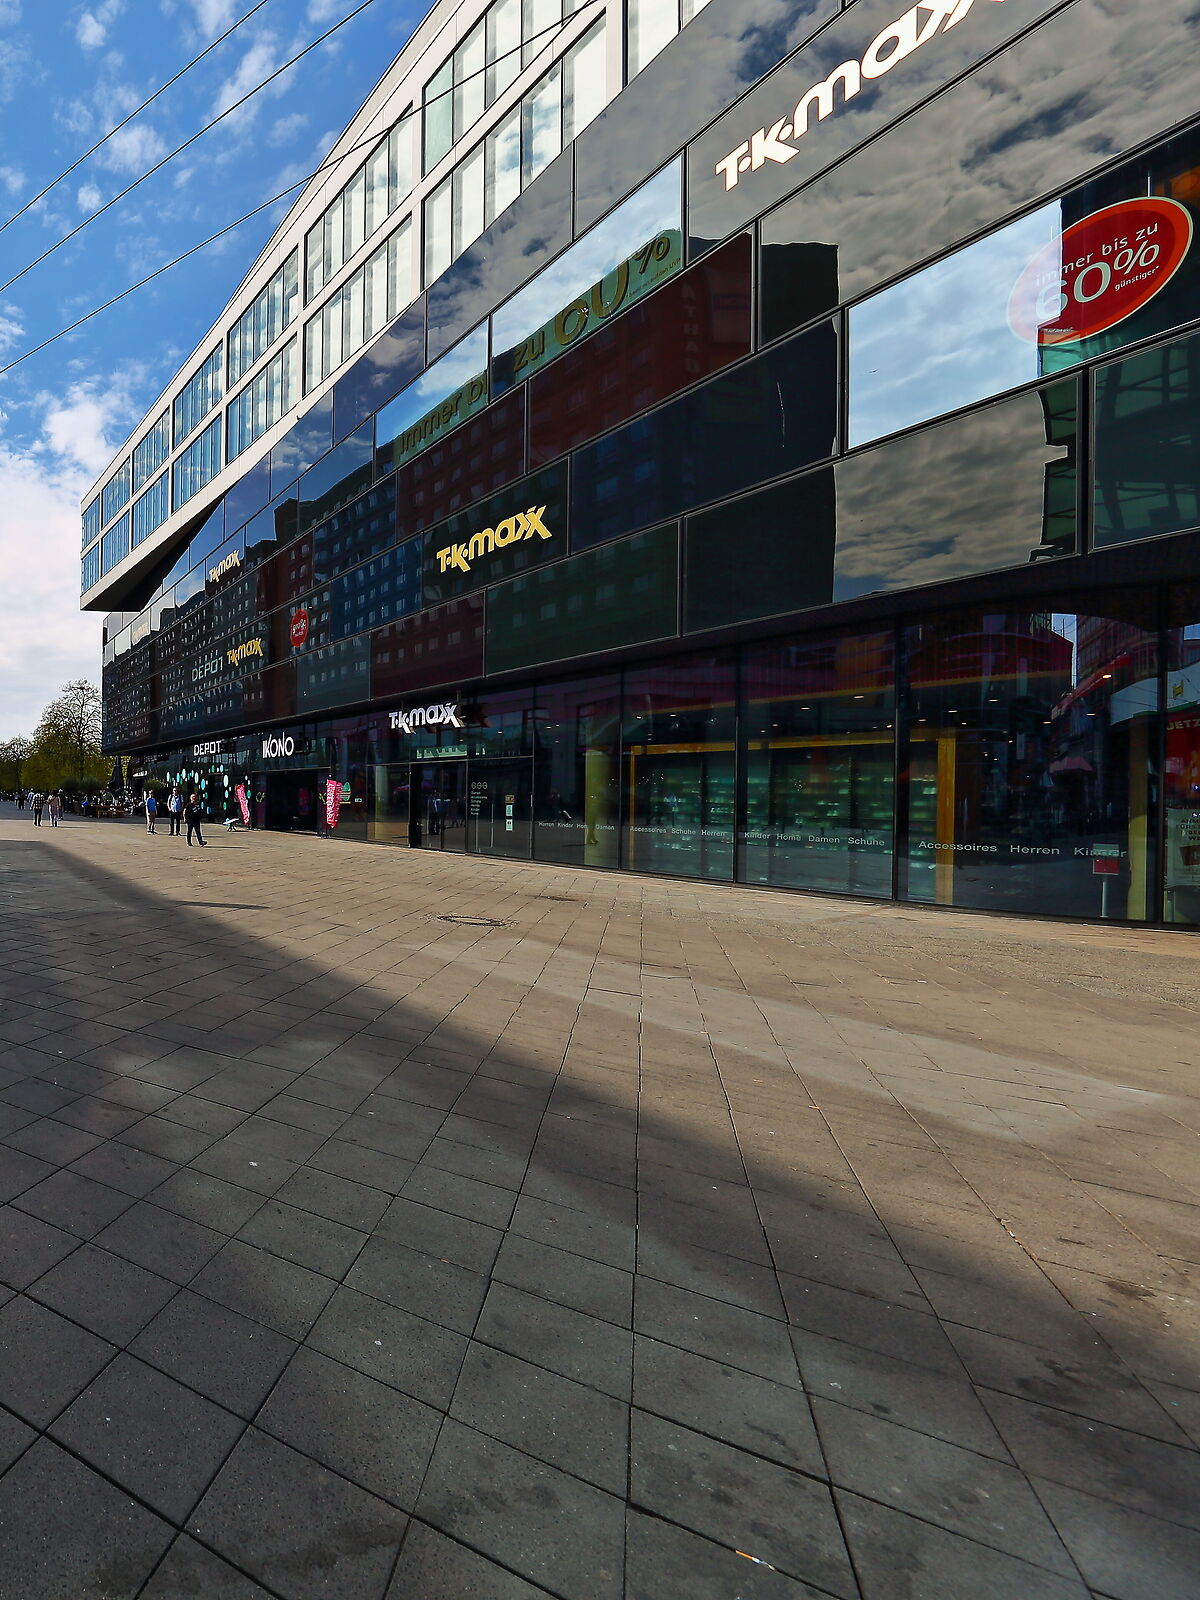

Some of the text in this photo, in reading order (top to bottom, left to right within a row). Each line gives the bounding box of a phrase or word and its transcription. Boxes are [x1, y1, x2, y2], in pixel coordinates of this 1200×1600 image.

[1101, 236, 1129, 256] bis
[1135, 220, 1160, 241] zu
[1035, 239, 1161, 319] 60%
[191, 655, 223, 682] DEPOT
[193, 740, 222, 756] DEPOT
[630, 825, 726, 837] Accessoires Schuhe Herren
[744, 831, 885, 847] Kinder Home Damen Schuhe
[918, 840, 1128, 858] Accessoires Herren Kinder
